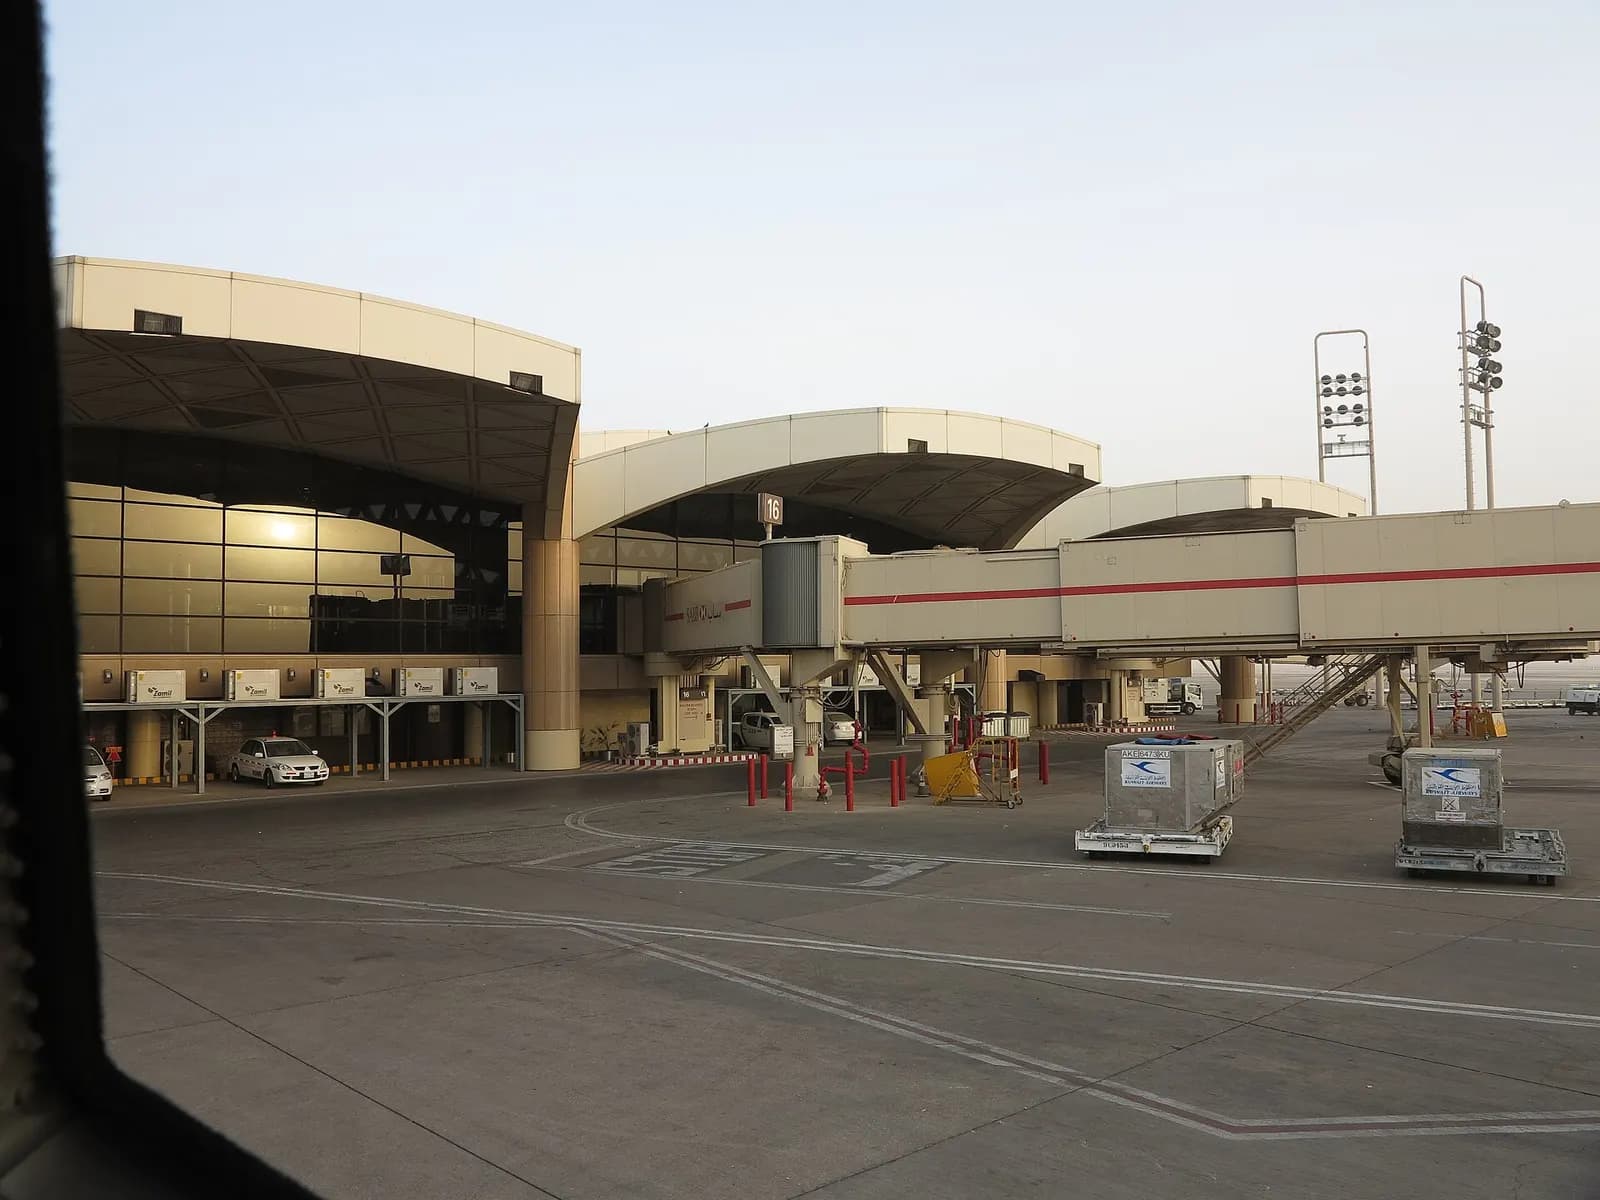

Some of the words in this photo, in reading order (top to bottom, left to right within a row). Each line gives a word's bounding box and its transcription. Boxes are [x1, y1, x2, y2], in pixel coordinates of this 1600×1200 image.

[767, 498, 780, 520] 16
[338, 685, 354, 693] Zamil
[418, 683, 433, 691] Zamil
[474, 682, 489, 690] Zamil
[152, 689, 173, 697] Zamil
[250, 687, 268, 695] Zamil
